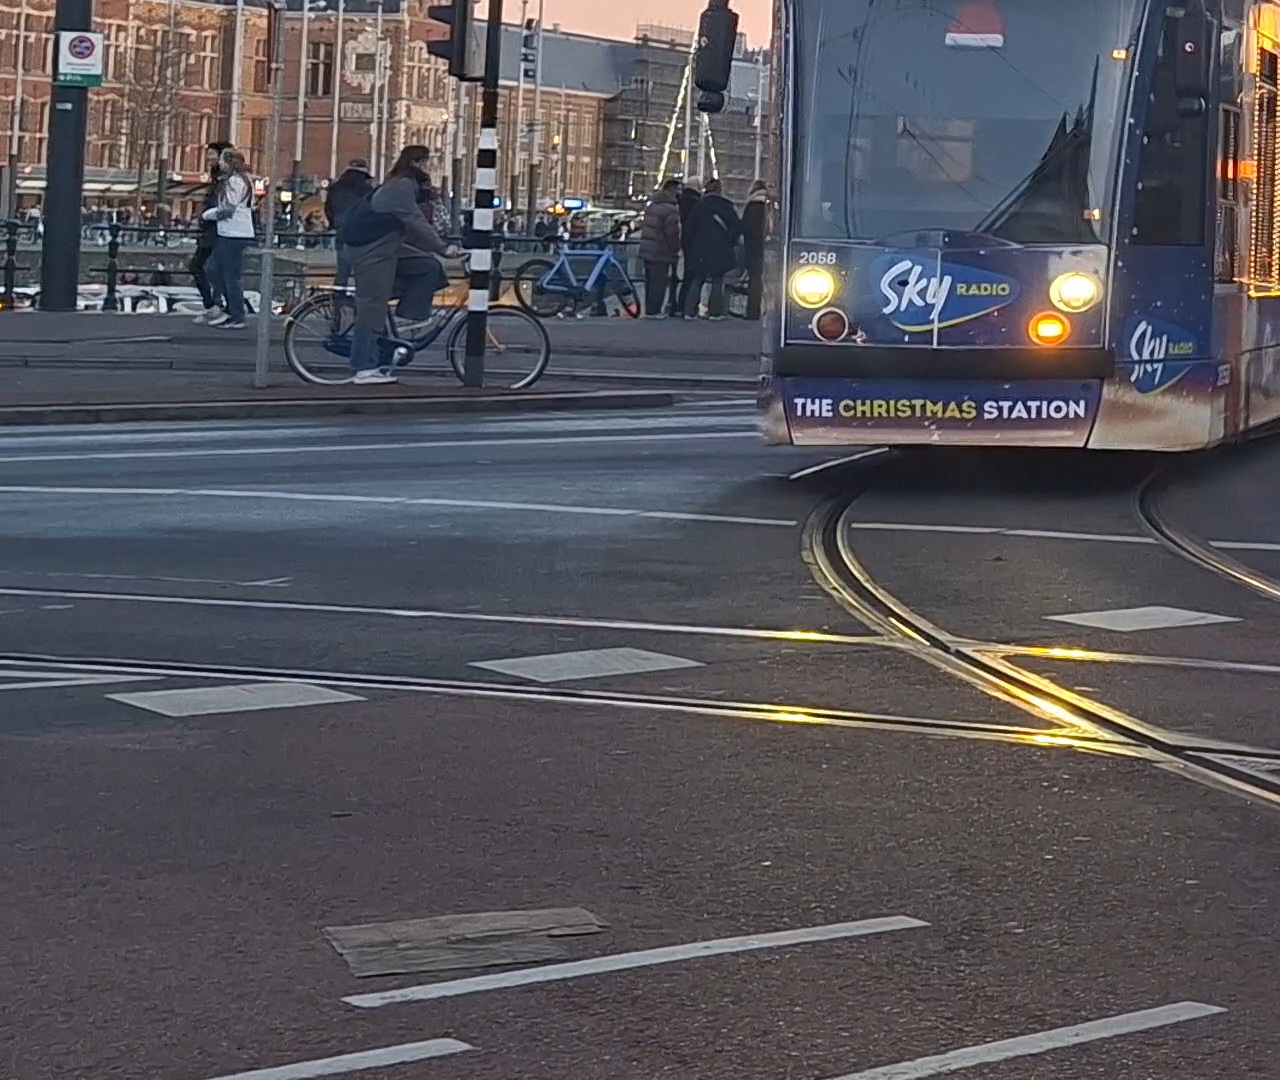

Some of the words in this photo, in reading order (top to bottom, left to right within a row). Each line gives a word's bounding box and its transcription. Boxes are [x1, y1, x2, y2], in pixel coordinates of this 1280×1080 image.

[799, 252, 836, 265] 2058
[880, 260, 952, 319] Sky
[956, 283, 1010, 295] RADIO
[1129, 320, 1167, 385] Sky
[794, 398, 833, 418] THE
[838, 399, 977, 419] CHRISTMAS
[983, 399, 1085, 419] STATION
